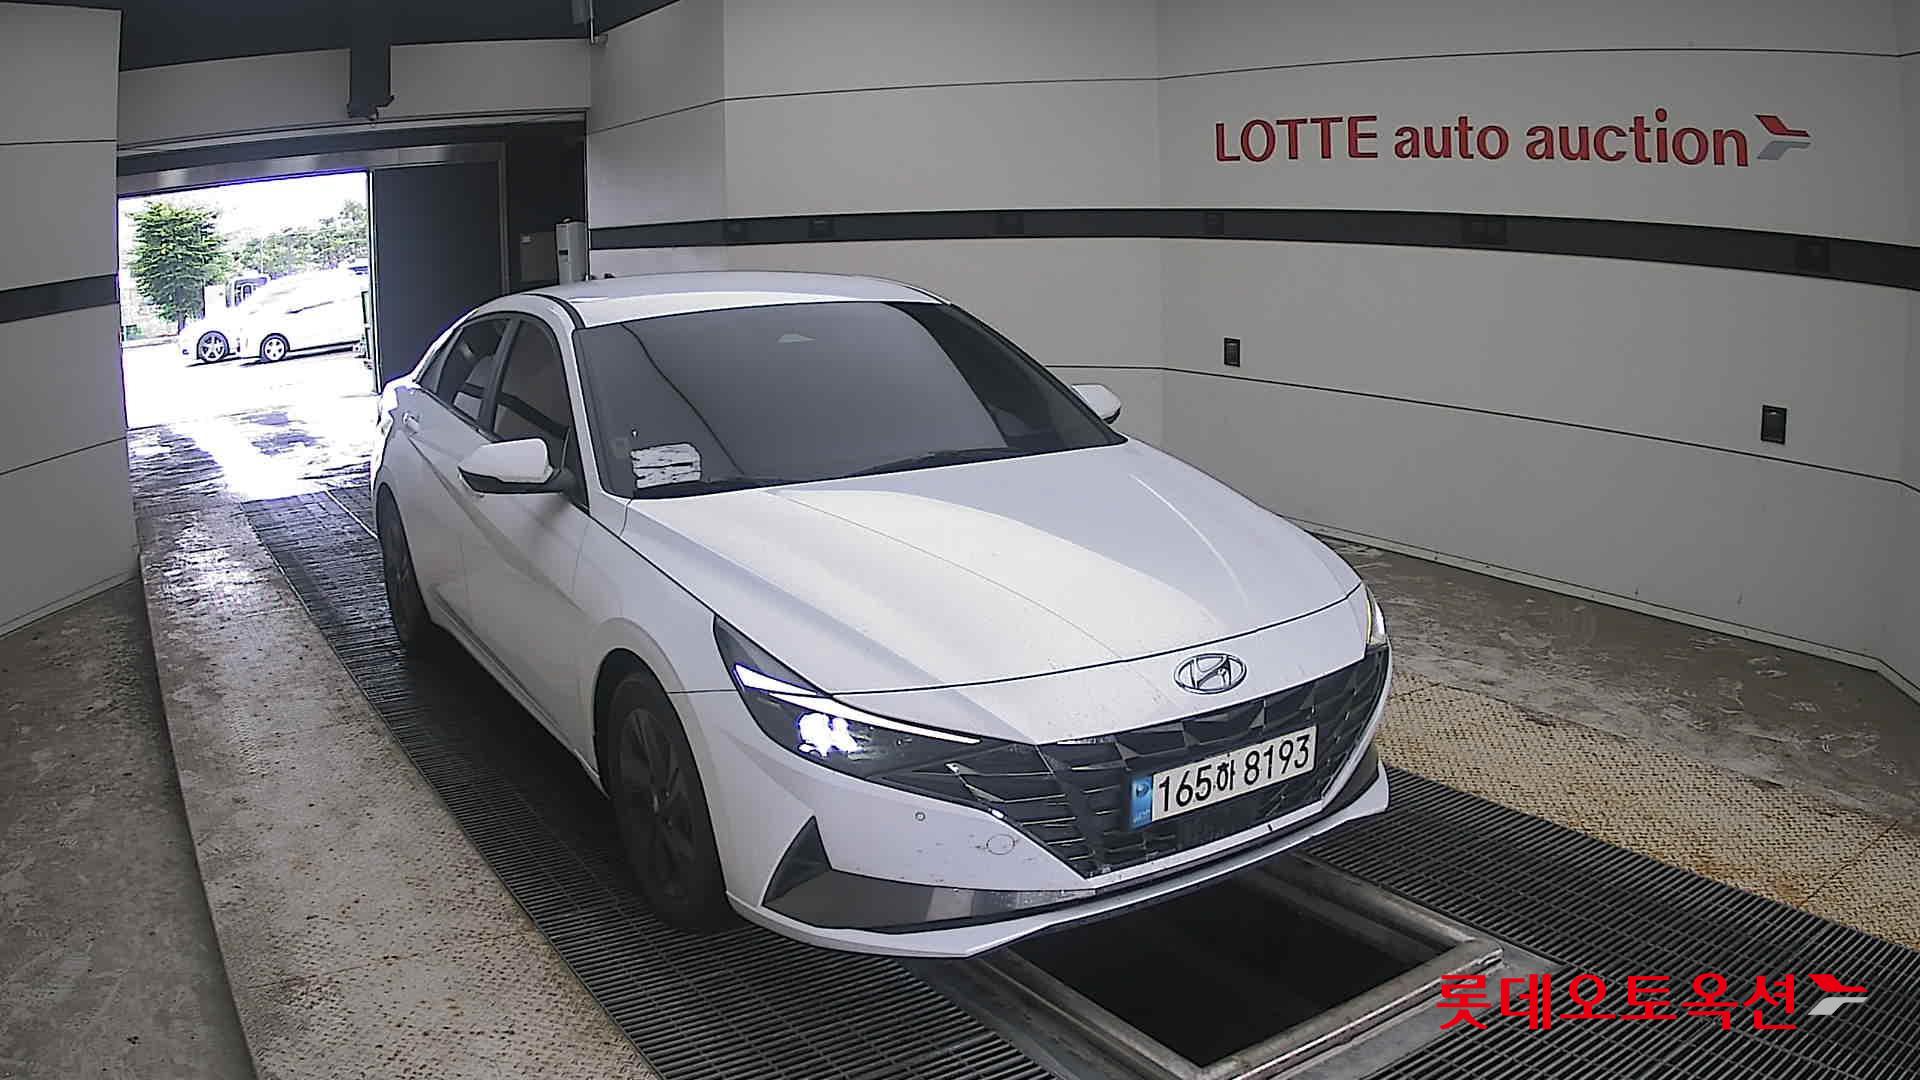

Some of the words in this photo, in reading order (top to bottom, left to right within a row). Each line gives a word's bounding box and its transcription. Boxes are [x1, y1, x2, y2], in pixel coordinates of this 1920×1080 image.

[1215, 115, 1379, 162] LOTTE
[1394, 116, 1509, 161] auto
[1525, 108, 1749, 167] auction
[1158, 759, 1236, 812] 165하
[1244, 734, 1311, 786] 8193
